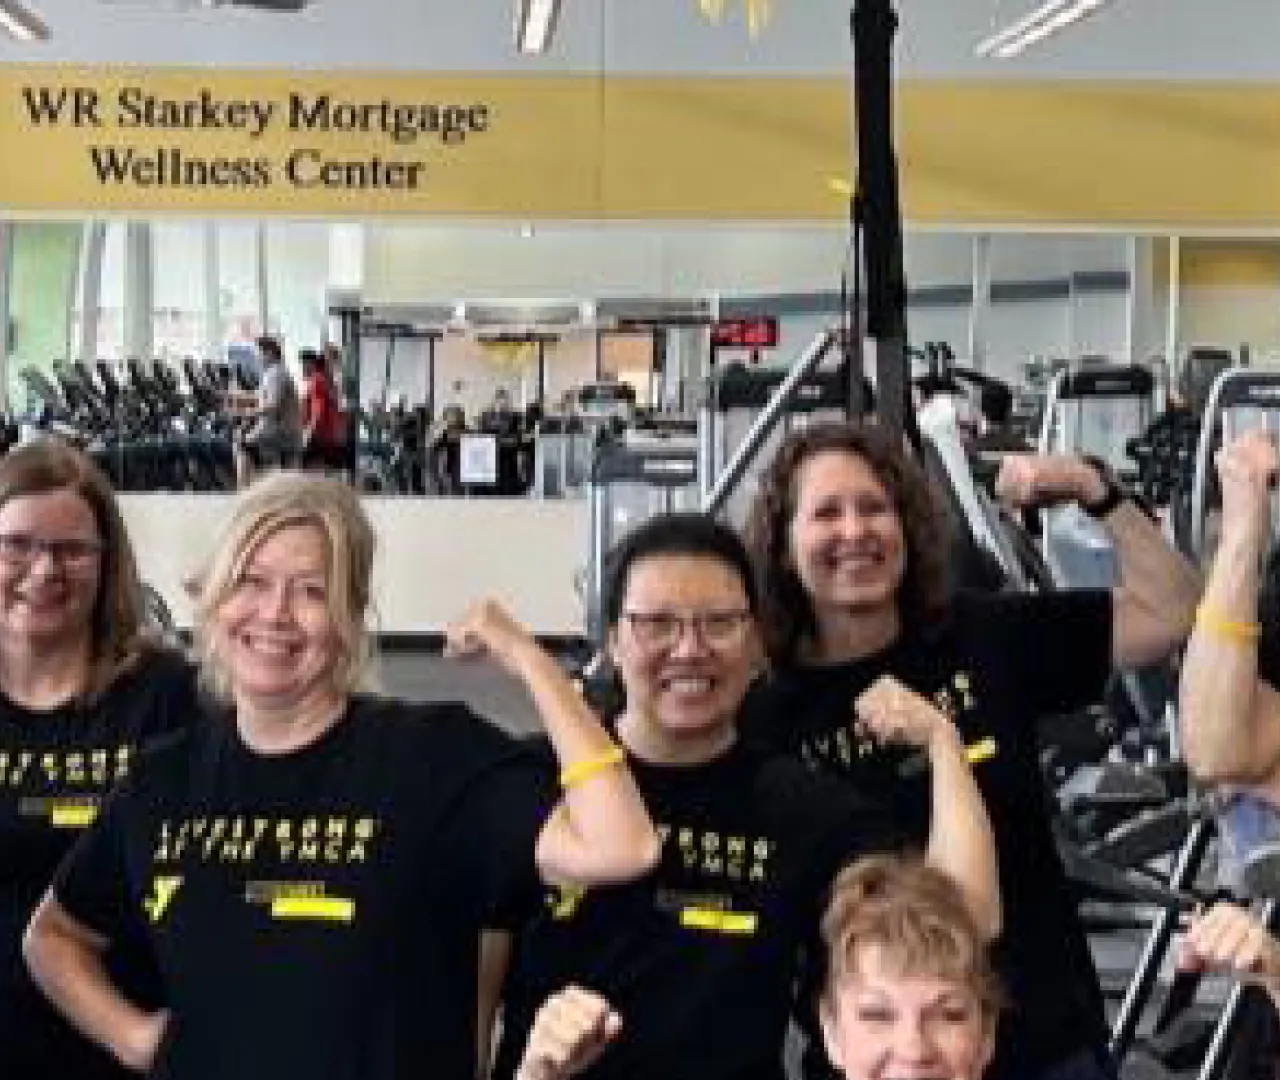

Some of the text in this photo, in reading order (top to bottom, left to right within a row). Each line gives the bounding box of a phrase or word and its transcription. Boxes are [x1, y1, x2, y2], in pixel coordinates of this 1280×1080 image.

[21, 87, 489, 141] WR Starkey Mortgage
[90, 146, 426, 190] Wellness Center
